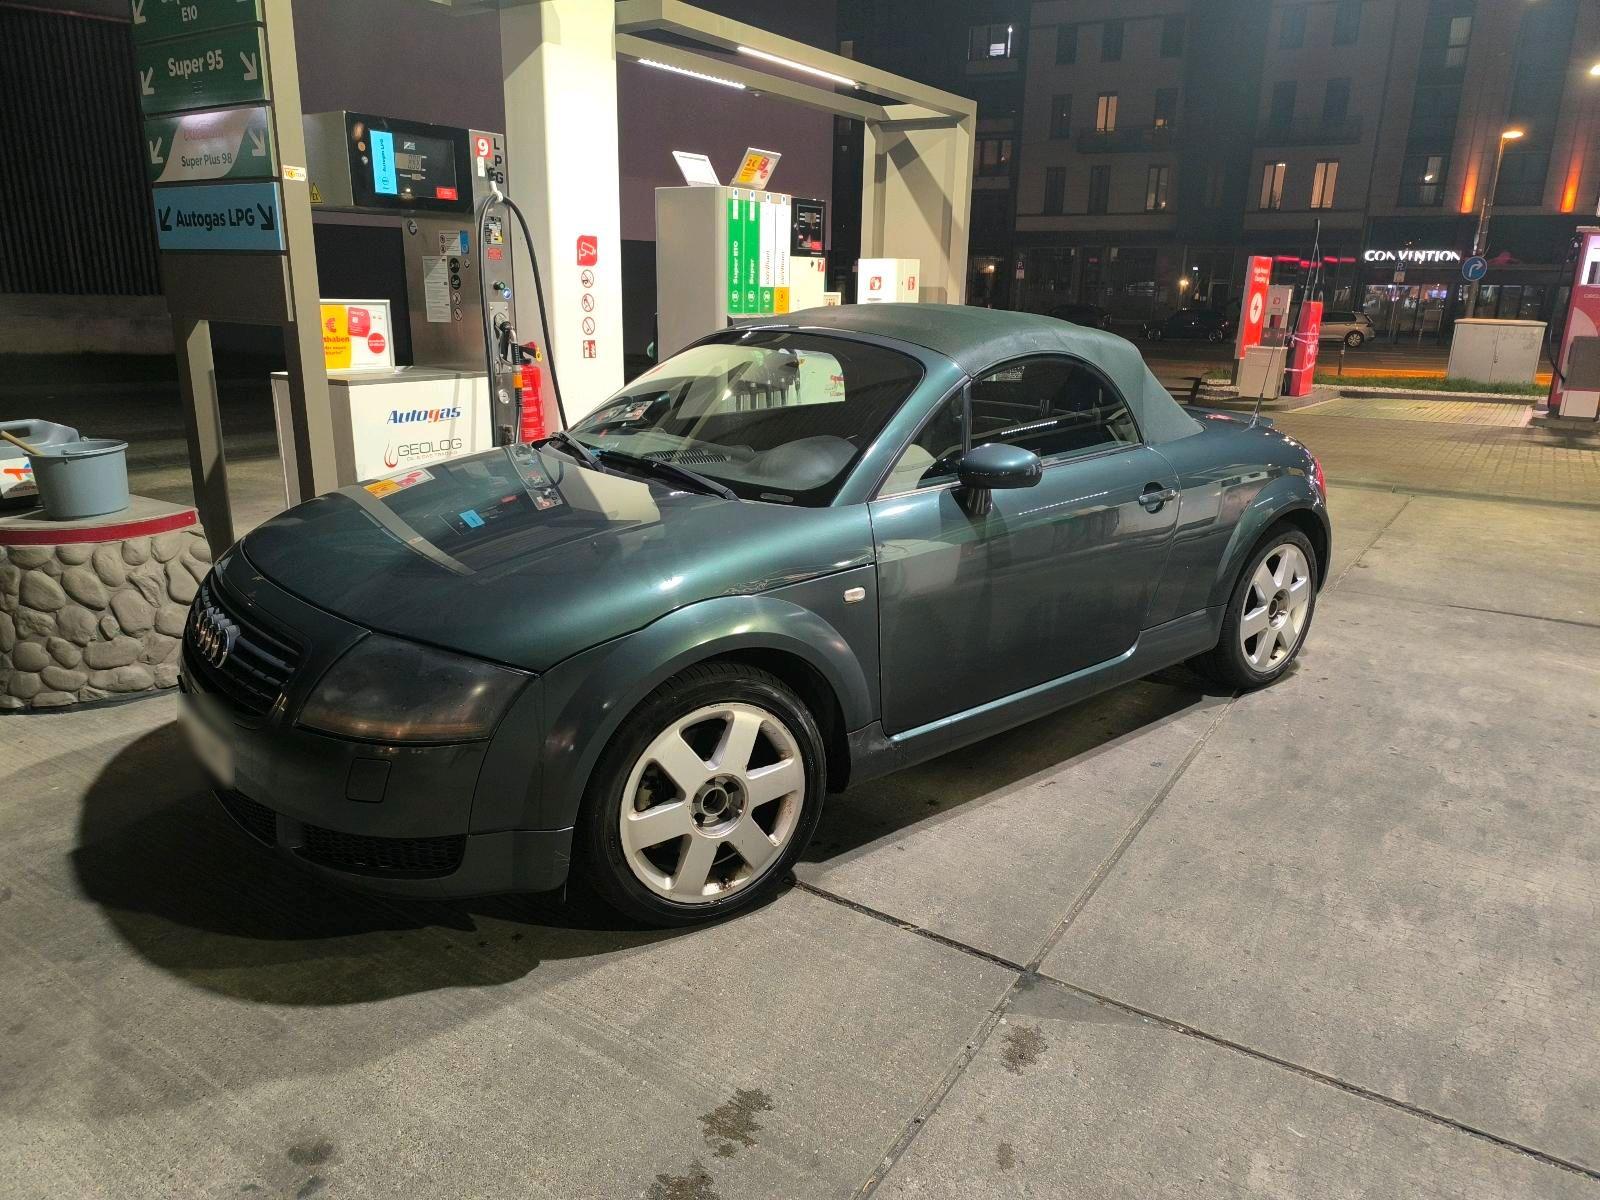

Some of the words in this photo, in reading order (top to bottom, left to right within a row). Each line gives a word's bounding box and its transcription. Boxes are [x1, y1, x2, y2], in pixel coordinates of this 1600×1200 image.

[181, 5, 198, 21] E10
[168, 56, 204, 79] Super
[206, 50, 224, 70] 95
[477, 138, 489, 156] 9
[181, 155, 203, 169] Super
[203, 153, 221, 166] Plus
[221, 152, 233, 164] 98
[176, 210, 226, 231] Autogas
[229, 208, 256, 227] LPG
[386, 406, 462, 424] Autogas
[397, 437, 463, 457] GEOLOG
